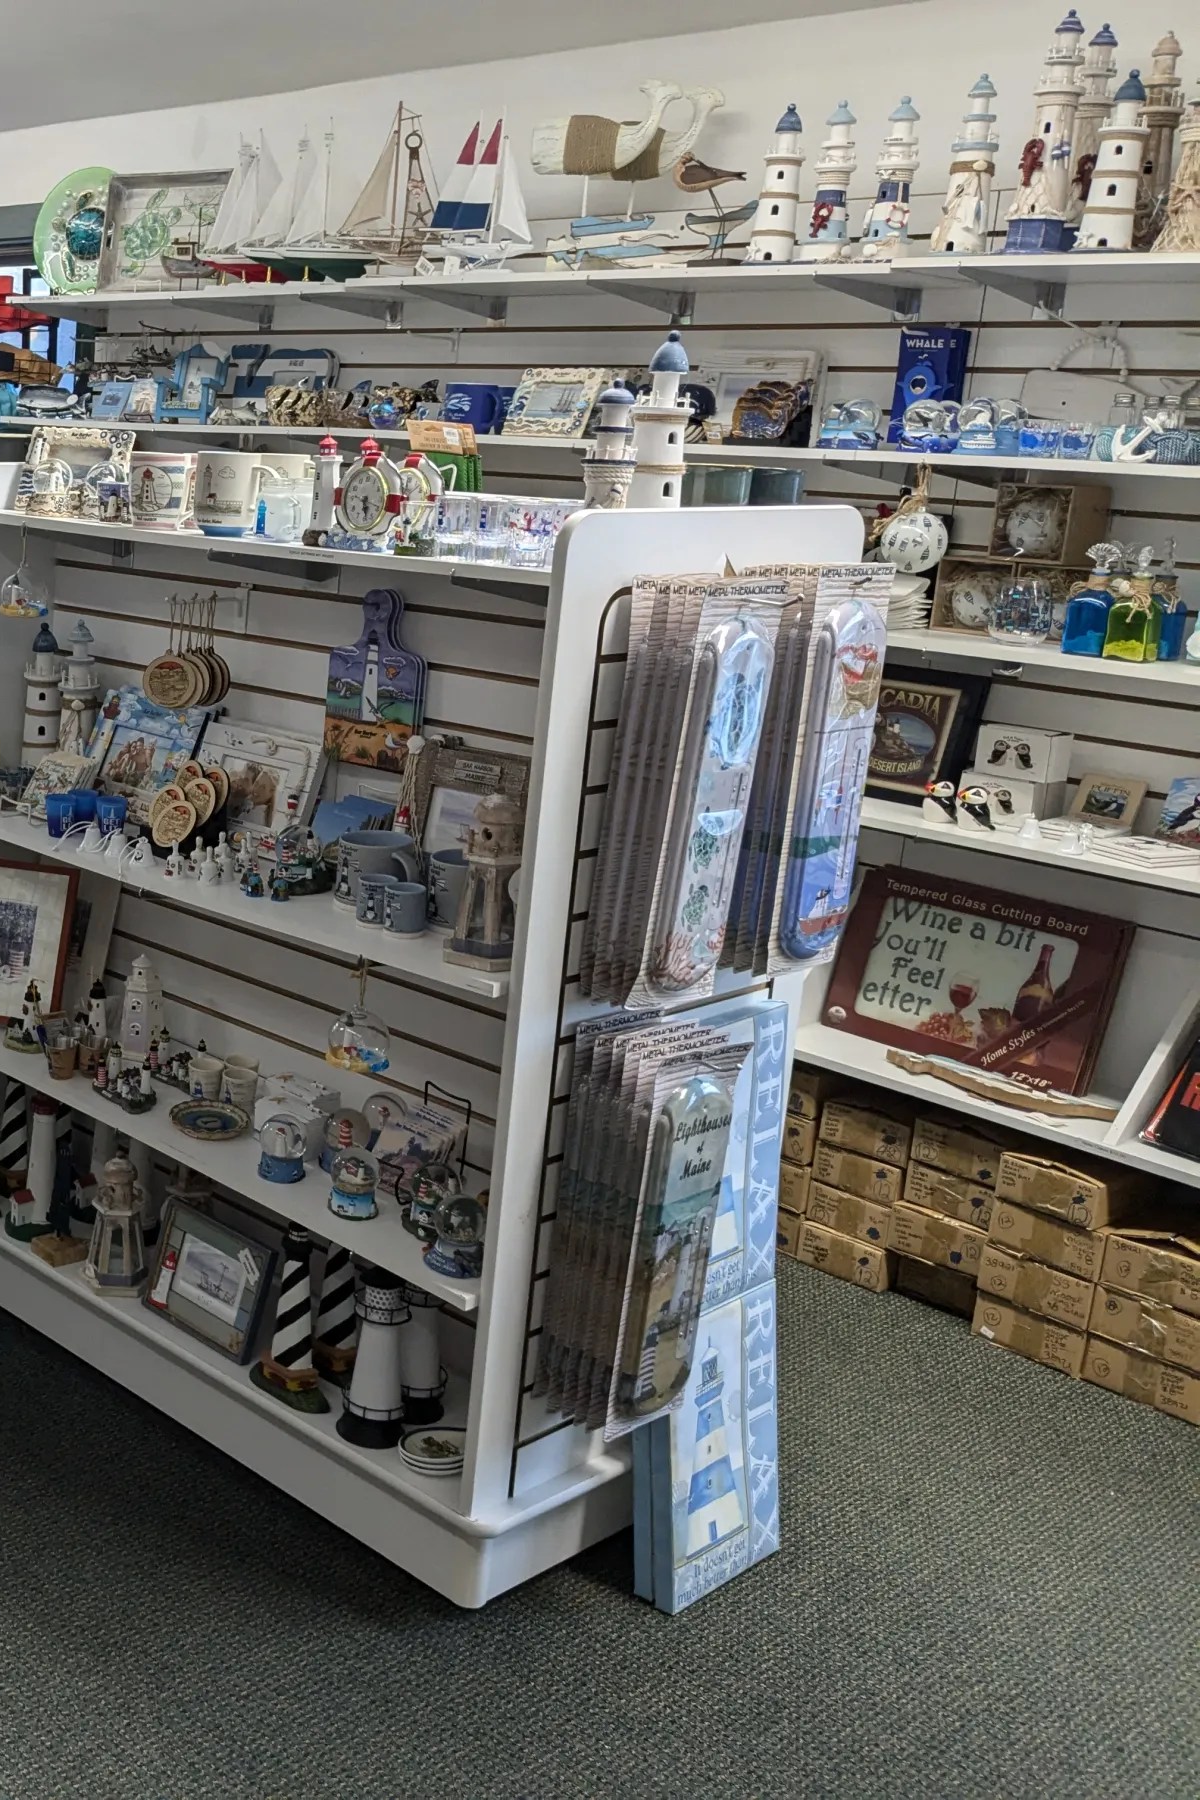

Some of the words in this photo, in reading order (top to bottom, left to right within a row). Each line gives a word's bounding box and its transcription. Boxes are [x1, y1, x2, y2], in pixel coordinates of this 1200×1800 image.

[905, 338, 945, 349] WHALE
[758, 567, 772, 576] MET
[774, 567, 788, 576] MET
[789, 567, 806, 576] META
[807, 567, 820, 576] MET
[821, 567, 843, 578] METAL
[843, 566, 896, 577] THERMOMETER
[636, 580, 657, 590] META
[672, 586, 686, 595] MET
[688, 586, 706, 596] META
[707, 586, 729, 597] METAL
[730, 584, 788, 596] THERMOMETER
[879, 687, 941, 725] CADIA
[886, 878, 948, 902] Tempered
[952, 894, 987, 911] Glass
[991, 904, 1042, 926] Cutting
[1046, 916, 1089, 936] Board
[888, 895, 963, 935] Wine
[969, 922, 987, 942] a
[995, 921, 1037, 953] bit
[890, 956, 945, 990] Feel
[861, 980, 932, 1017] etter
[579, 1022, 604, 1034] METAL
[605, 1009, 661, 1029] THERMOMETER
[642, 1049, 668, 1060] METAL
[668, 1035, 728, 1055] THERMOMETER
[653, 1029, 711, 1046] THERMOMETER
[980, 1046, 1008, 1067] Home
[1008, 1028, 1036, 1052] Styles
[673, 1113, 732, 1146] Lighthouses
[696, 1142, 704, 1154] of
[748, 1019, 786, 1273] RELAX
[680, 1158, 711, 1180] Maine
[744, 1298, 777, 1551] RELAX
[693, 1563, 702, 1580] It
[702, 1546, 732, 1577] doesn't
[732, 1539, 747, 1562] get
[676, 1581, 703, 1607] much
[702, 1566, 728, 1593] better
